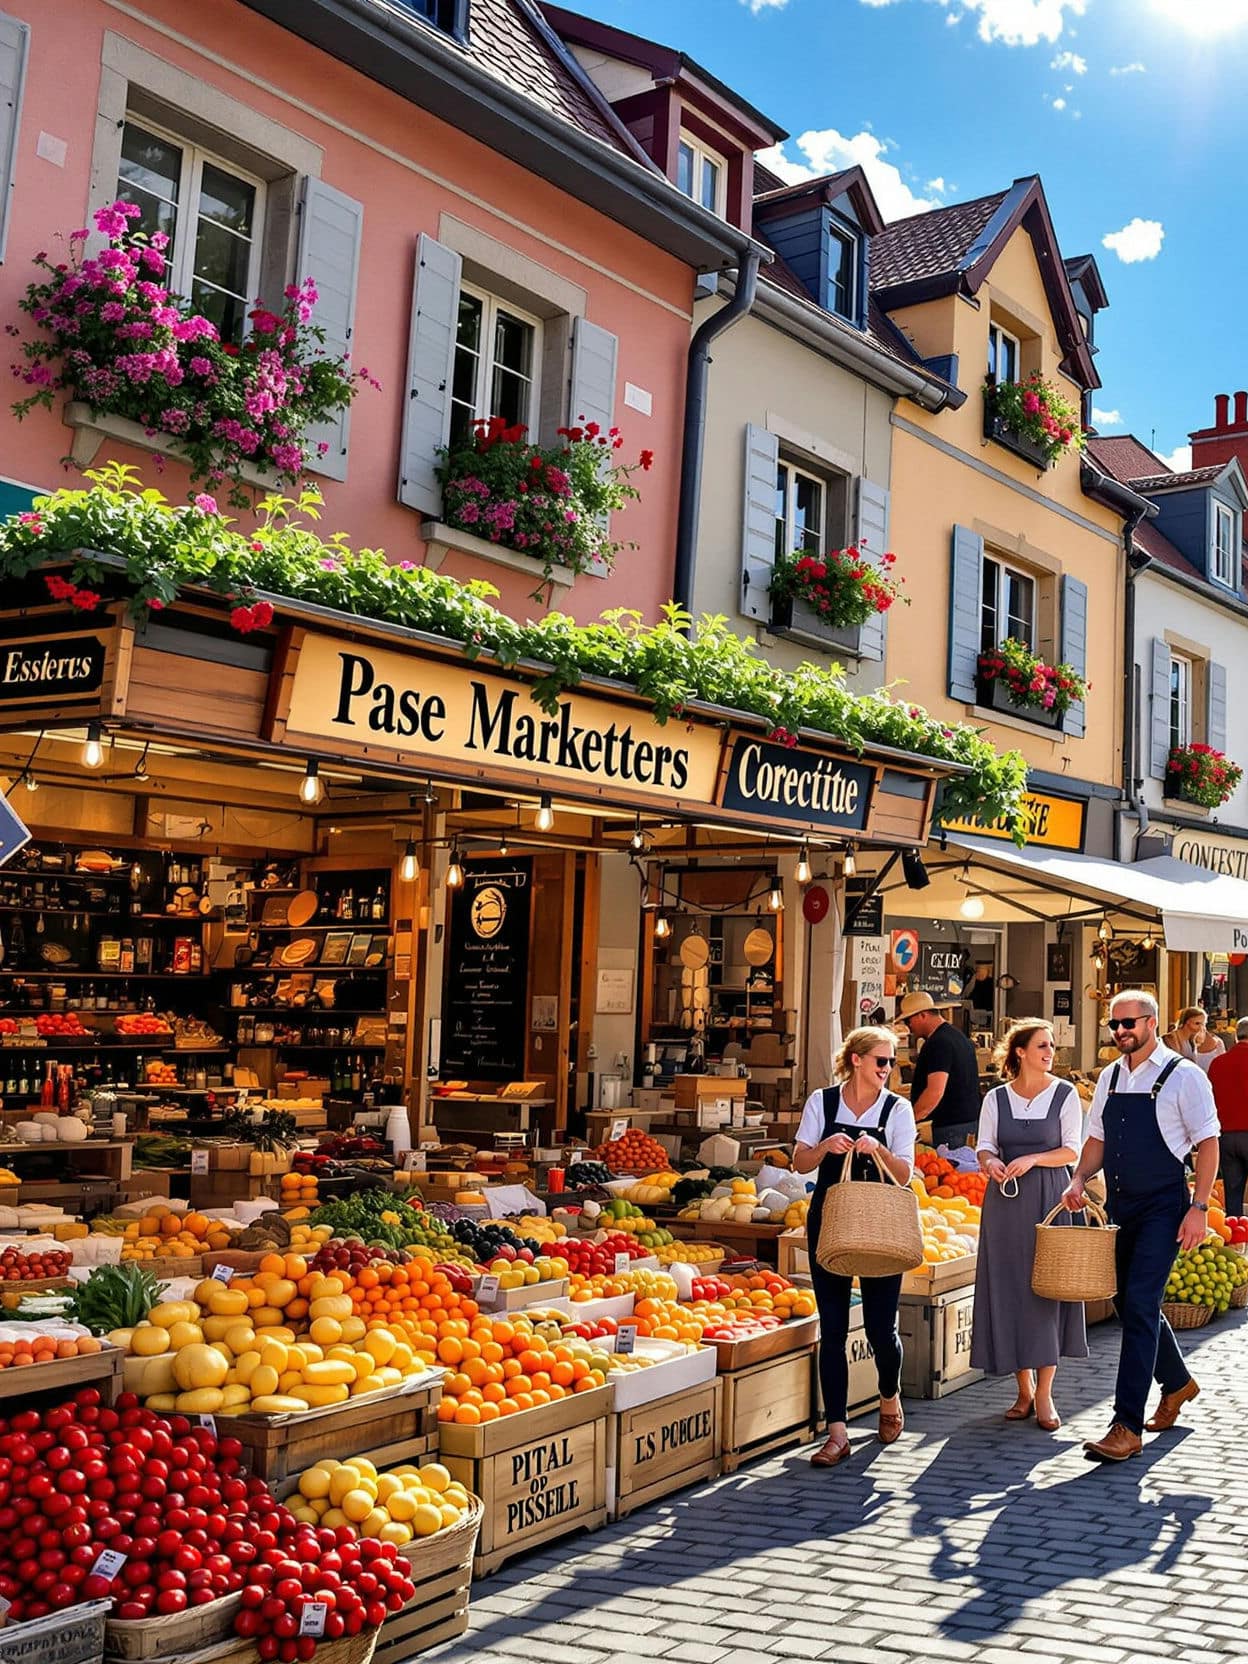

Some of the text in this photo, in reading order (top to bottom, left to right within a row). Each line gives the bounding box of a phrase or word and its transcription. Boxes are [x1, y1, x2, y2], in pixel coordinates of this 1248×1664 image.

[332, 651, 689, 790] Pase Marketters
[512, 1437, 574, 1486] PITAL
